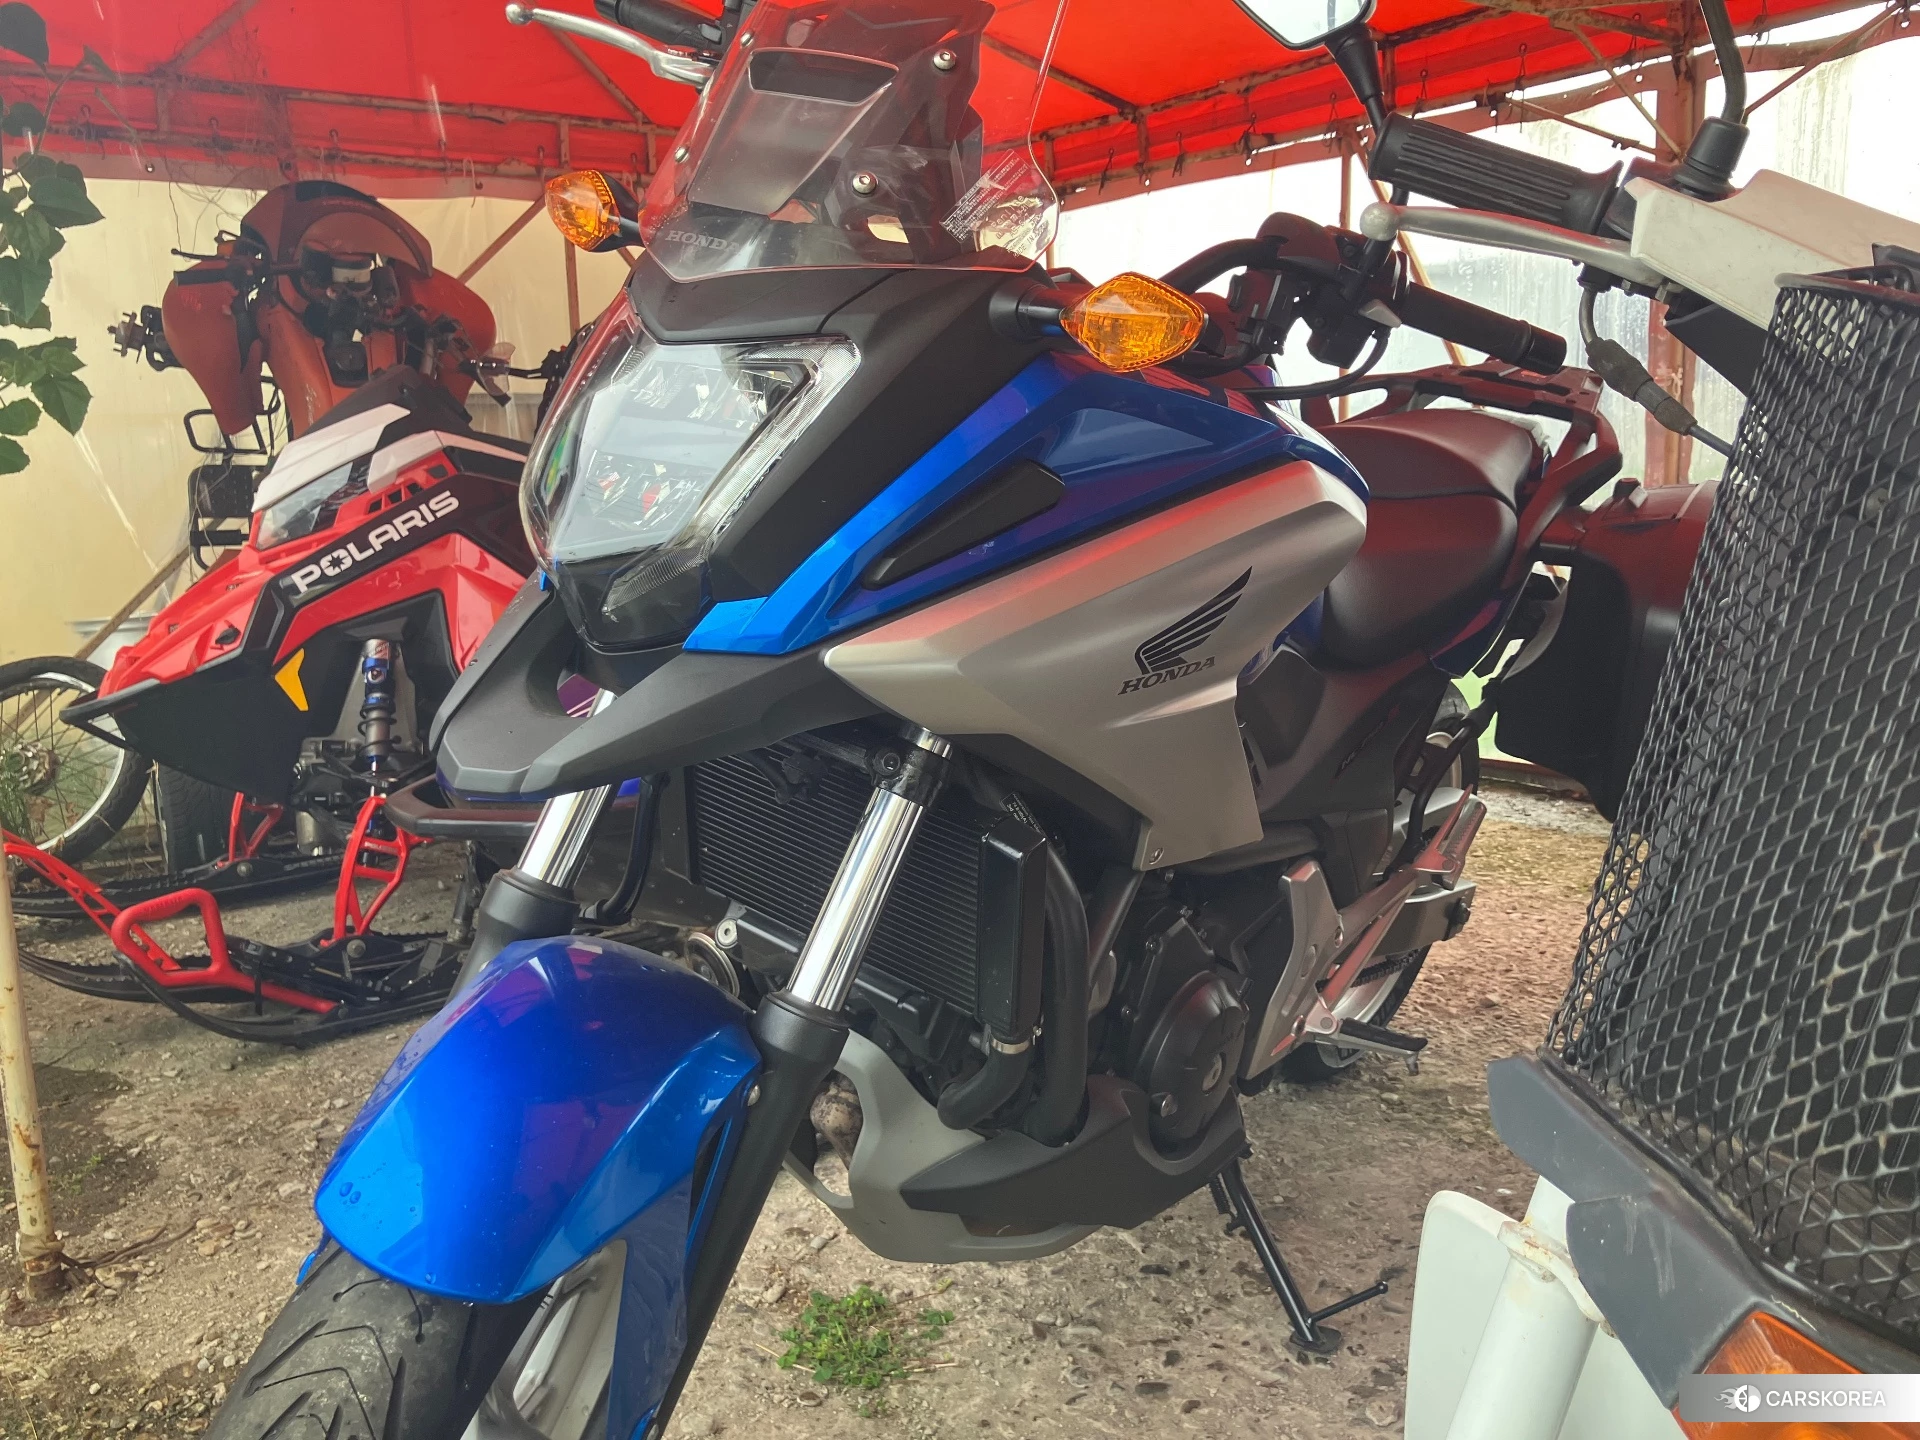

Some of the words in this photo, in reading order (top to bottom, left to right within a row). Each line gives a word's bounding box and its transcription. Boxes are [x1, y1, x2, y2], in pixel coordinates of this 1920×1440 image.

[665, 230, 740, 253] HONDA
[291, 490, 459, 594] POLARIS
[1117, 656, 1216, 695] HONDA
